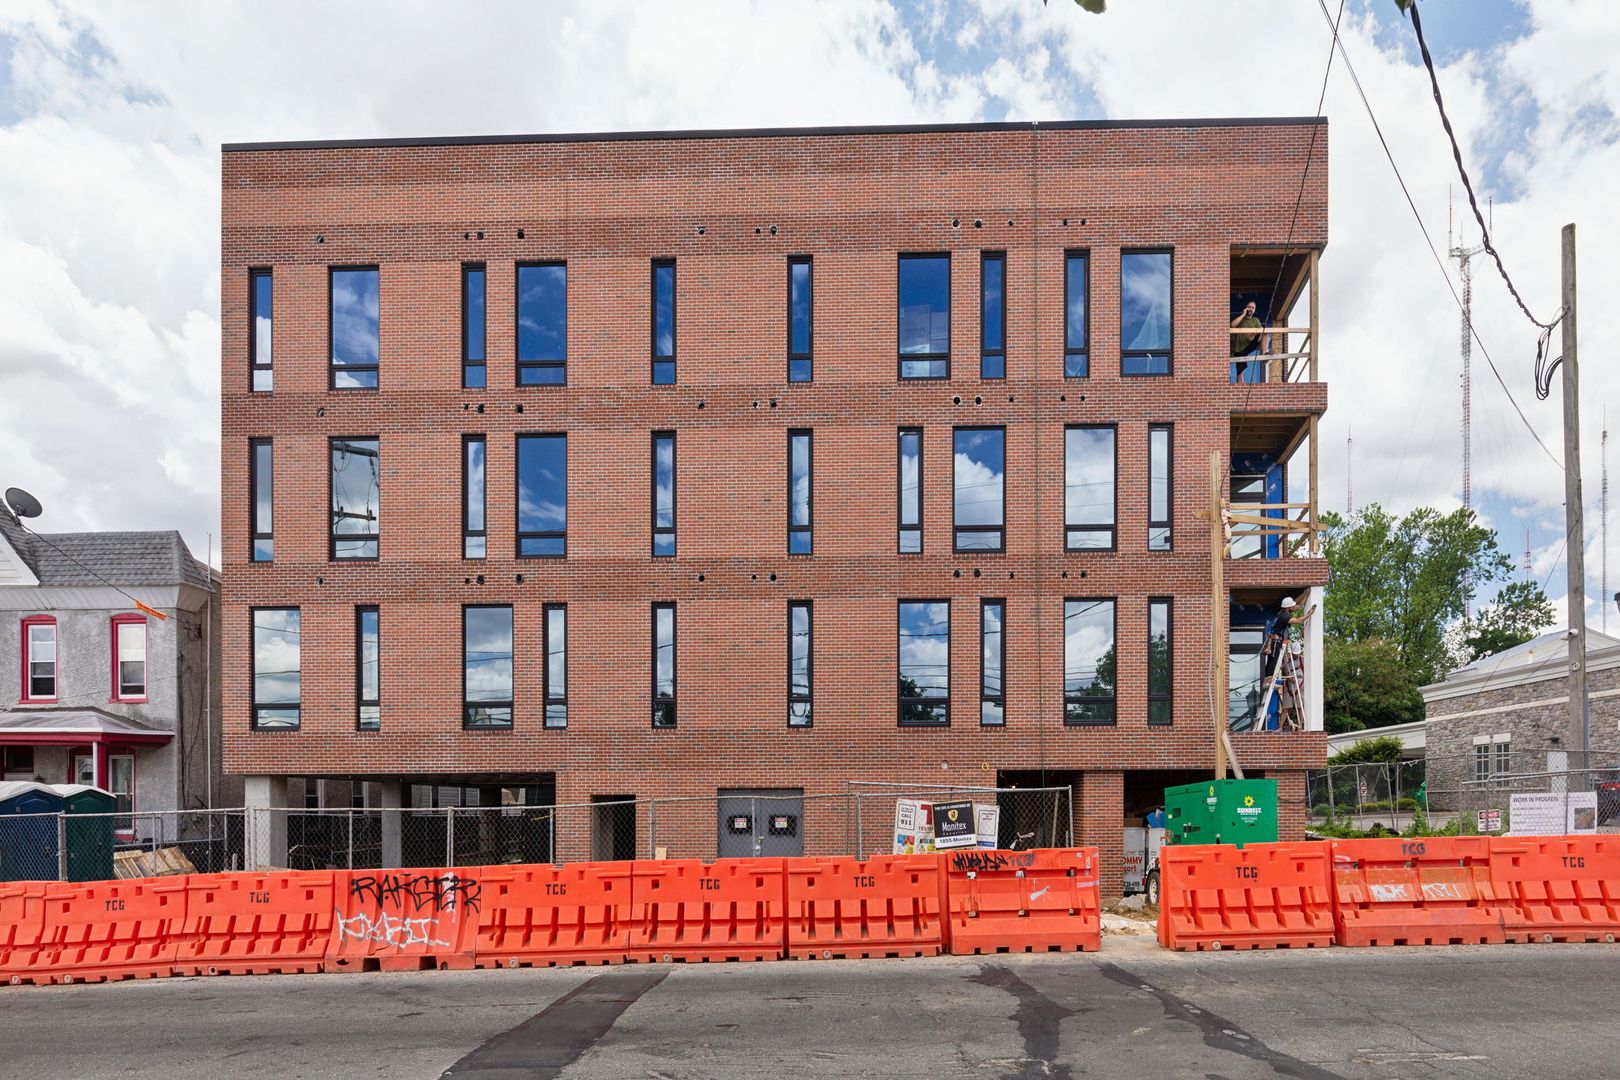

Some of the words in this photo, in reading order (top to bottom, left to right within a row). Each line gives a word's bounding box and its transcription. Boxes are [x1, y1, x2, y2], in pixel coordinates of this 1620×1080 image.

[941, 822, 967, 832] Monitex
[1401, 843, 1426, 855] TCG
[1562, 857, 1585, 868] TCG
[1235, 866, 1259, 878] TCG
[698, 878, 721, 891] TCG
[853, 875, 876, 888] TCG
[545, 883, 567, 896] TCG
[249, 892, 270, 904] TCG
[105, 899, 125, 912] TCG
